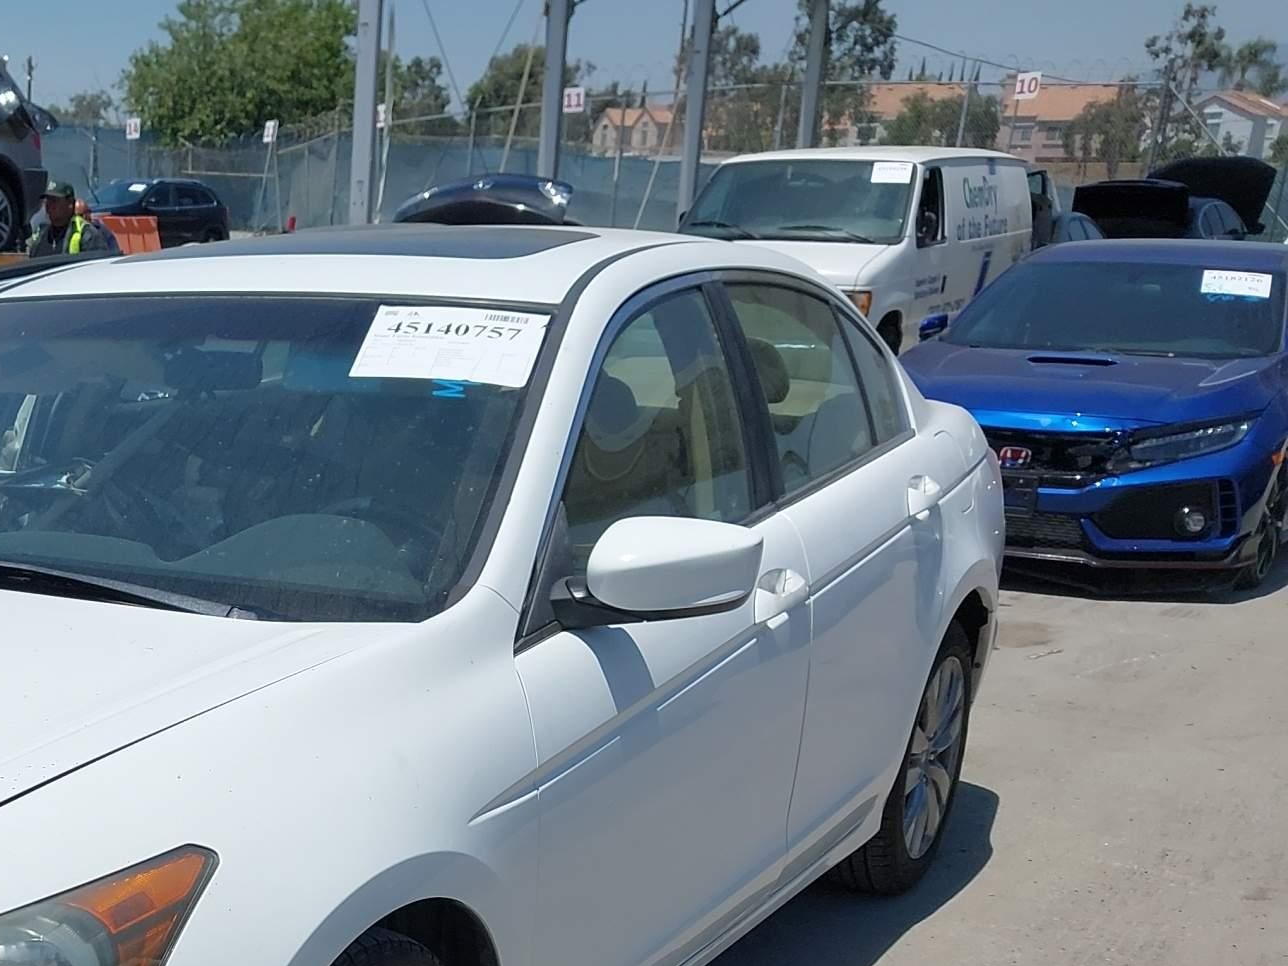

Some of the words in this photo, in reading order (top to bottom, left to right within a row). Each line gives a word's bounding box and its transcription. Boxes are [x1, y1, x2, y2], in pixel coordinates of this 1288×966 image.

[1016, 76, 1039, 95] 10
[565, 92, 581, 108] 11
[956, 216, 966, 241] of
[968, 215, 982, 239] the
[984, 213, 1009, 236] Future
[387, 320, 523, 341] 45140757
